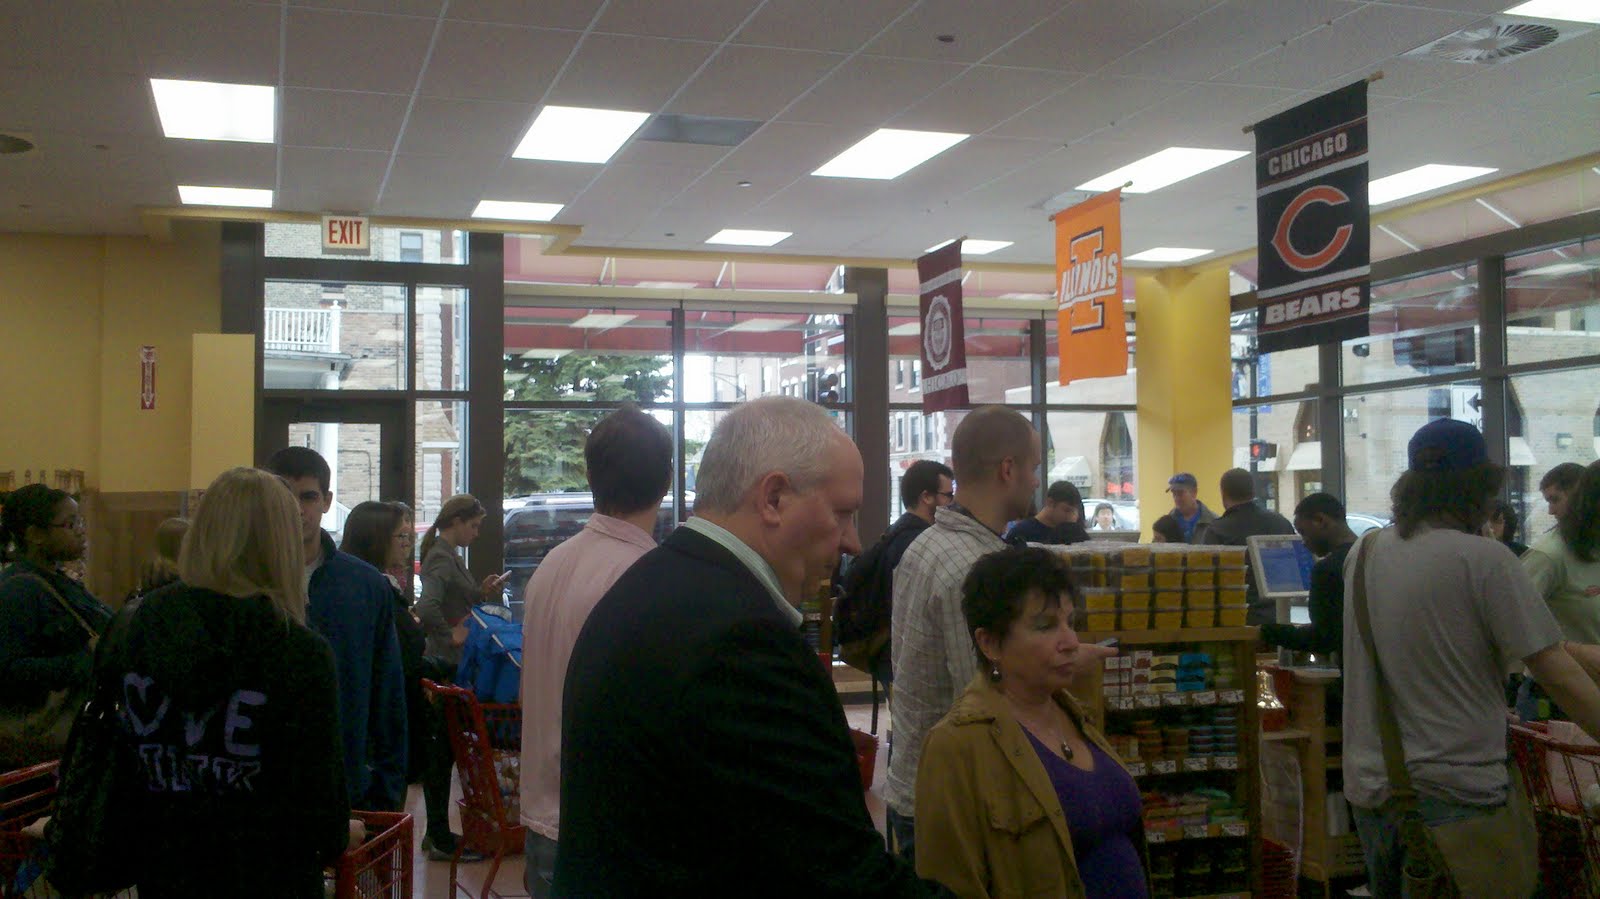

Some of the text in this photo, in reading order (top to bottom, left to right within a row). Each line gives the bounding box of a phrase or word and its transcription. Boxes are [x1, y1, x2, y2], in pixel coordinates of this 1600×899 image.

[1268, 133, 1347, 176] CHICAGO
[328, 219, 363, 245] EXIT
[1271, 185, 1353, 272] C
[1059, 253, 1118, 304] ILLINOIS
[1265, 286, 1361, 325] BEARS
